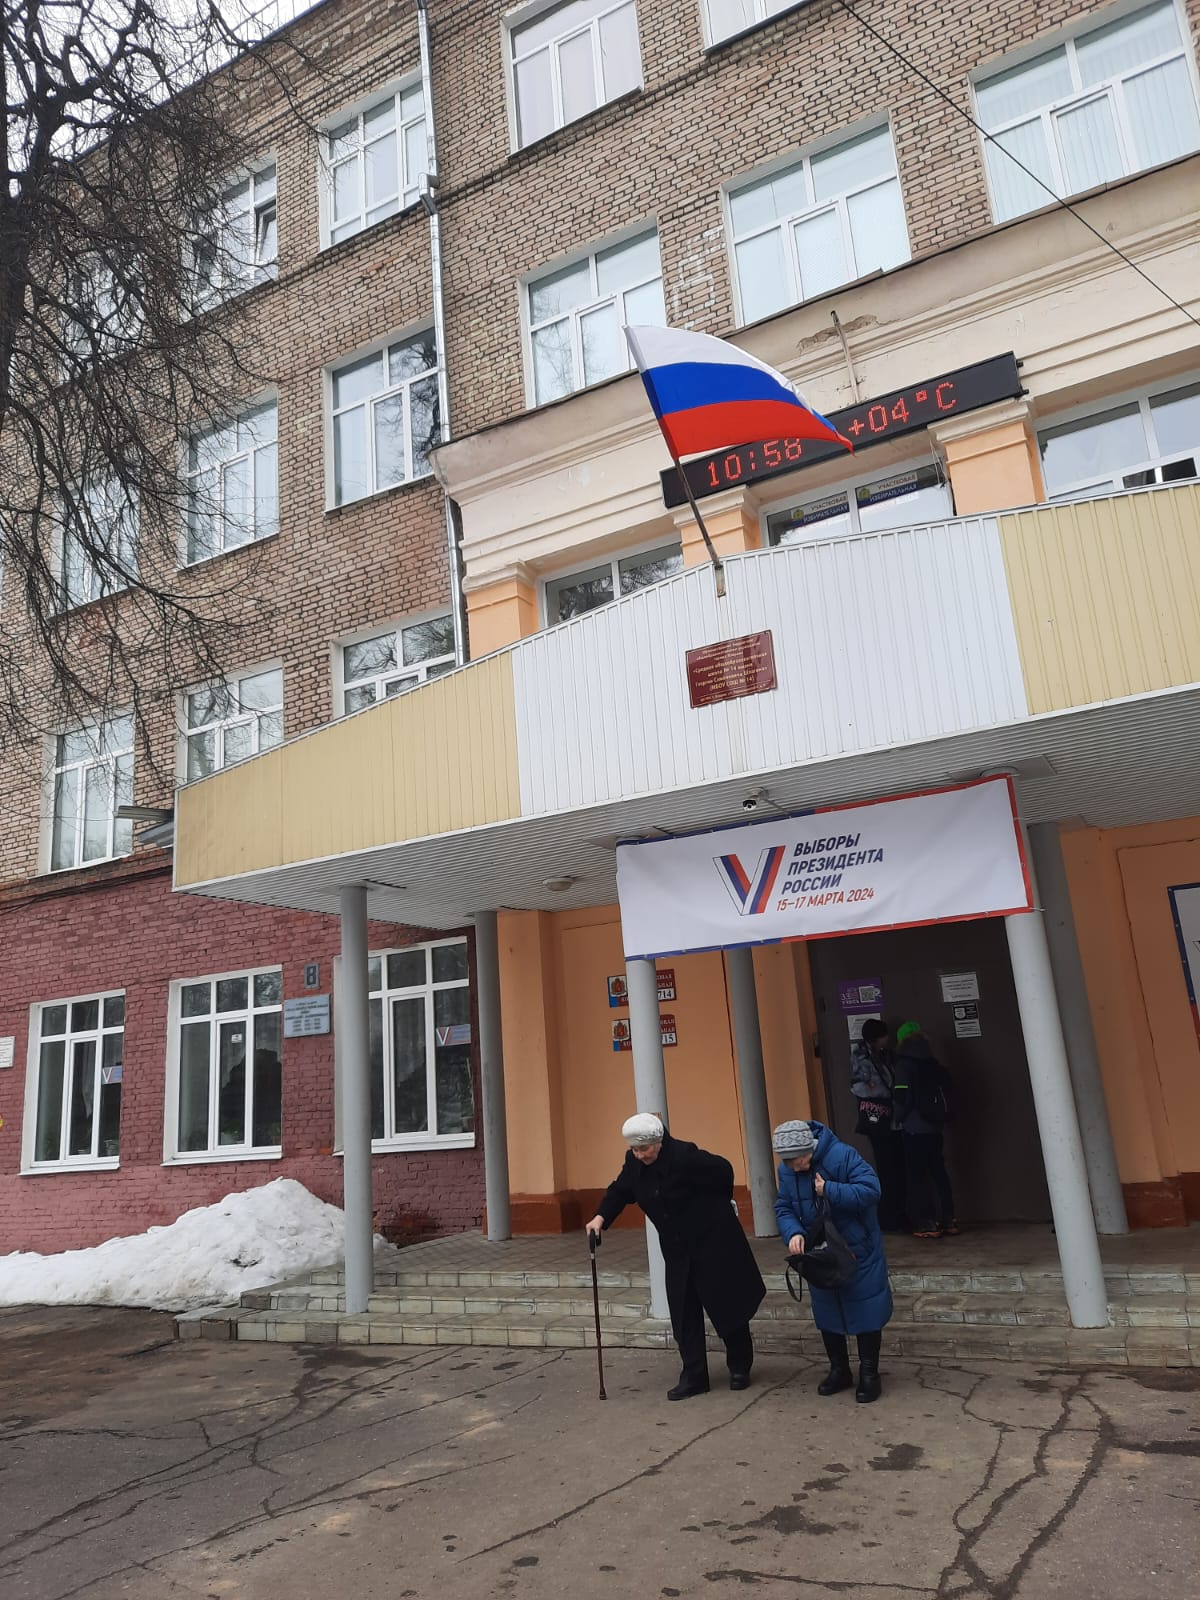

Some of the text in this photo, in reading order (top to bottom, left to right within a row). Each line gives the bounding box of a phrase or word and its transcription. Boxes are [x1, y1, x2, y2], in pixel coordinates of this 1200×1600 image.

[707, 438, 803, 487] 10:58
[793, 833, 862, 857] ВЫБОРЫ
[787, 847, 885, 877] ПРЕЗИДЕНТА
[781, 873, 843, 896] РОССИИ
[806, 891, 846, 909] МАРТА
[846, 887, 876, 903] 2024
